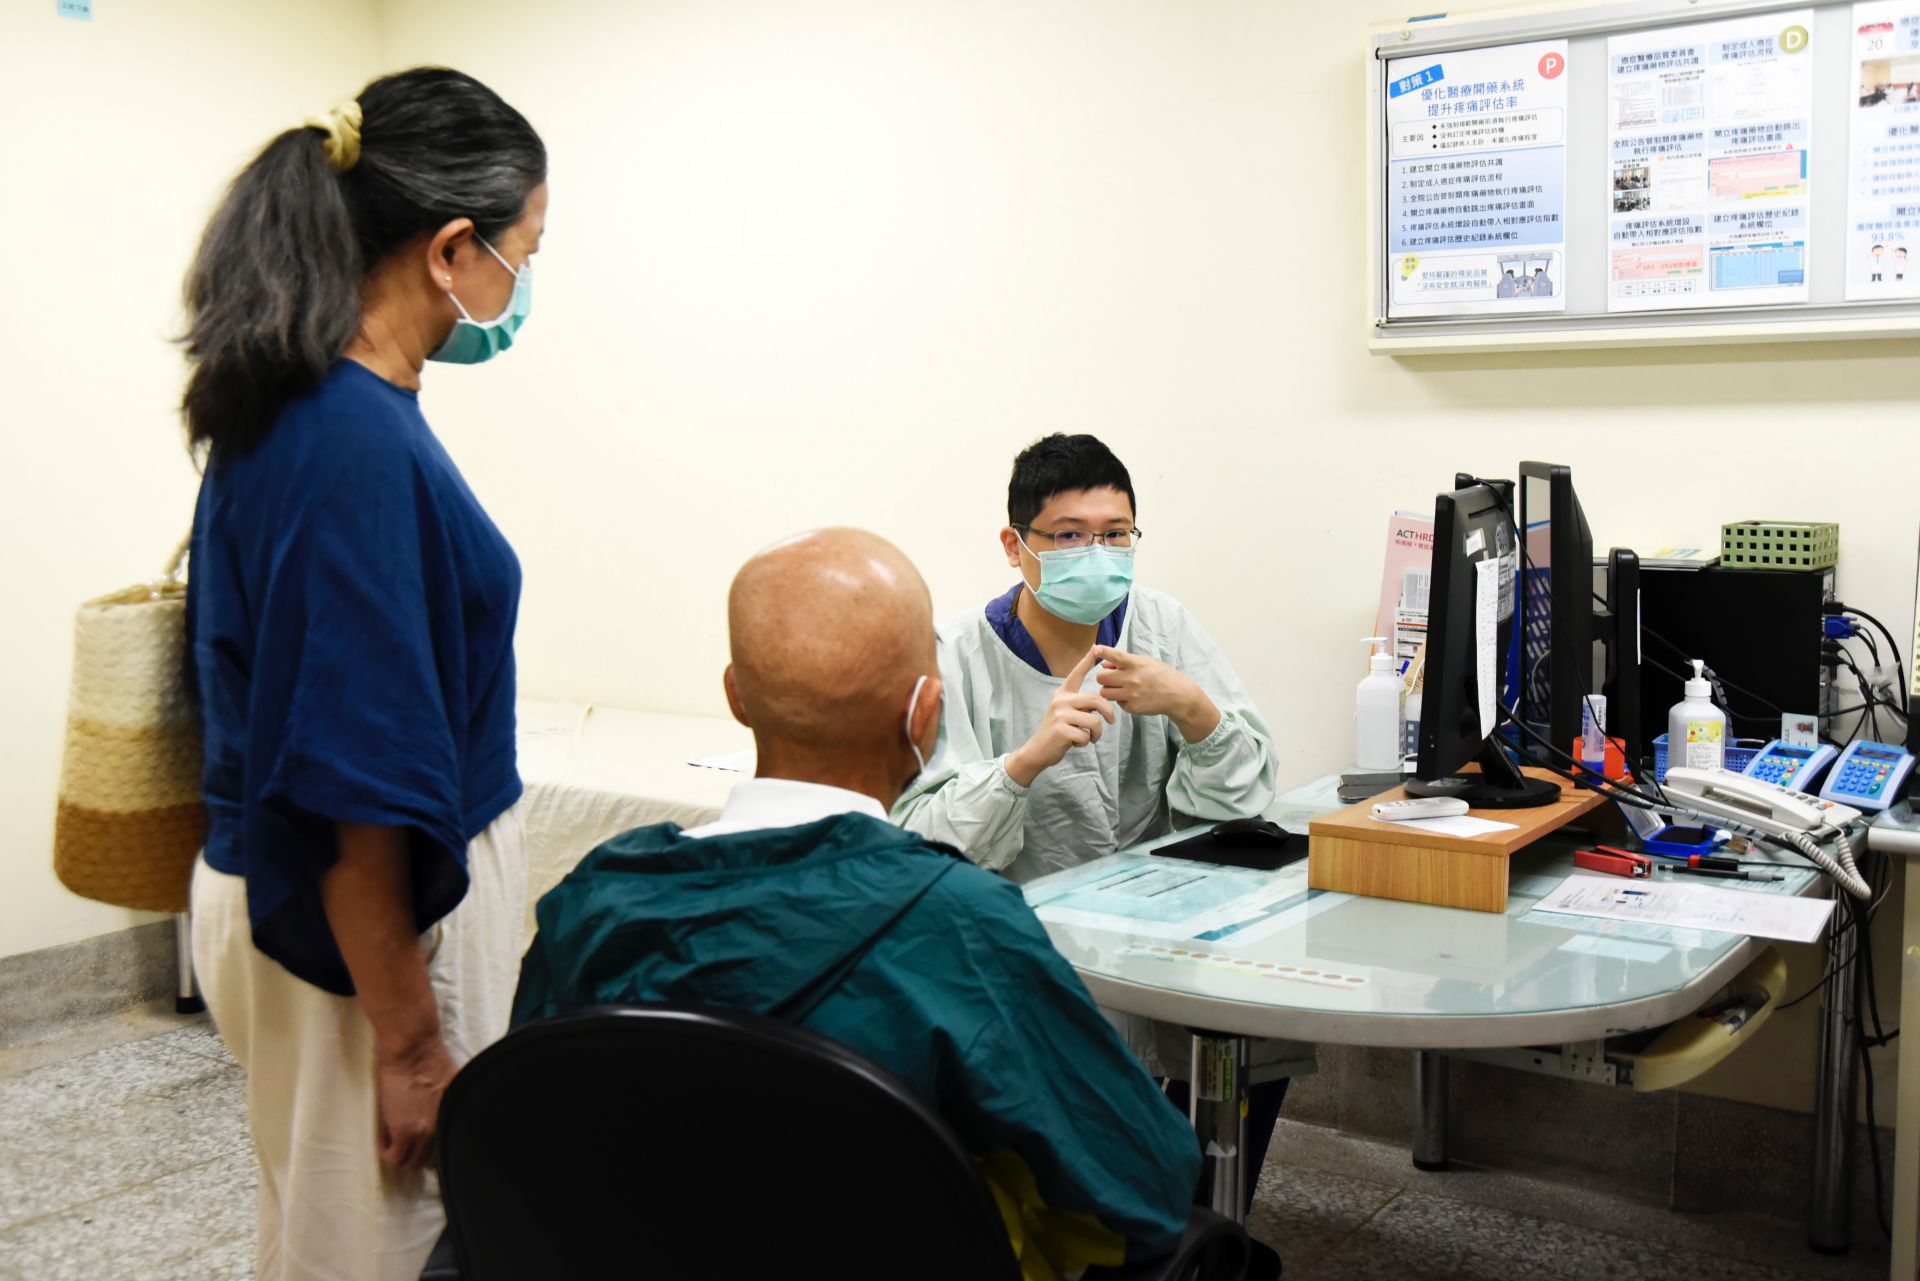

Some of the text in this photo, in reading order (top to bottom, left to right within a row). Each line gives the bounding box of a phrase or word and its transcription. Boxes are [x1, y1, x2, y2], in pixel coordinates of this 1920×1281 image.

[1786, 31, 1801, 49] D
[1546, 58, 1556, 74] P
[1421, 78, 1525, 101] 優化醫療開藥系統
[1427, 96, 1519, 117] 提升疼痛評估率
[1402, 133, 1424, 143] 主要因
